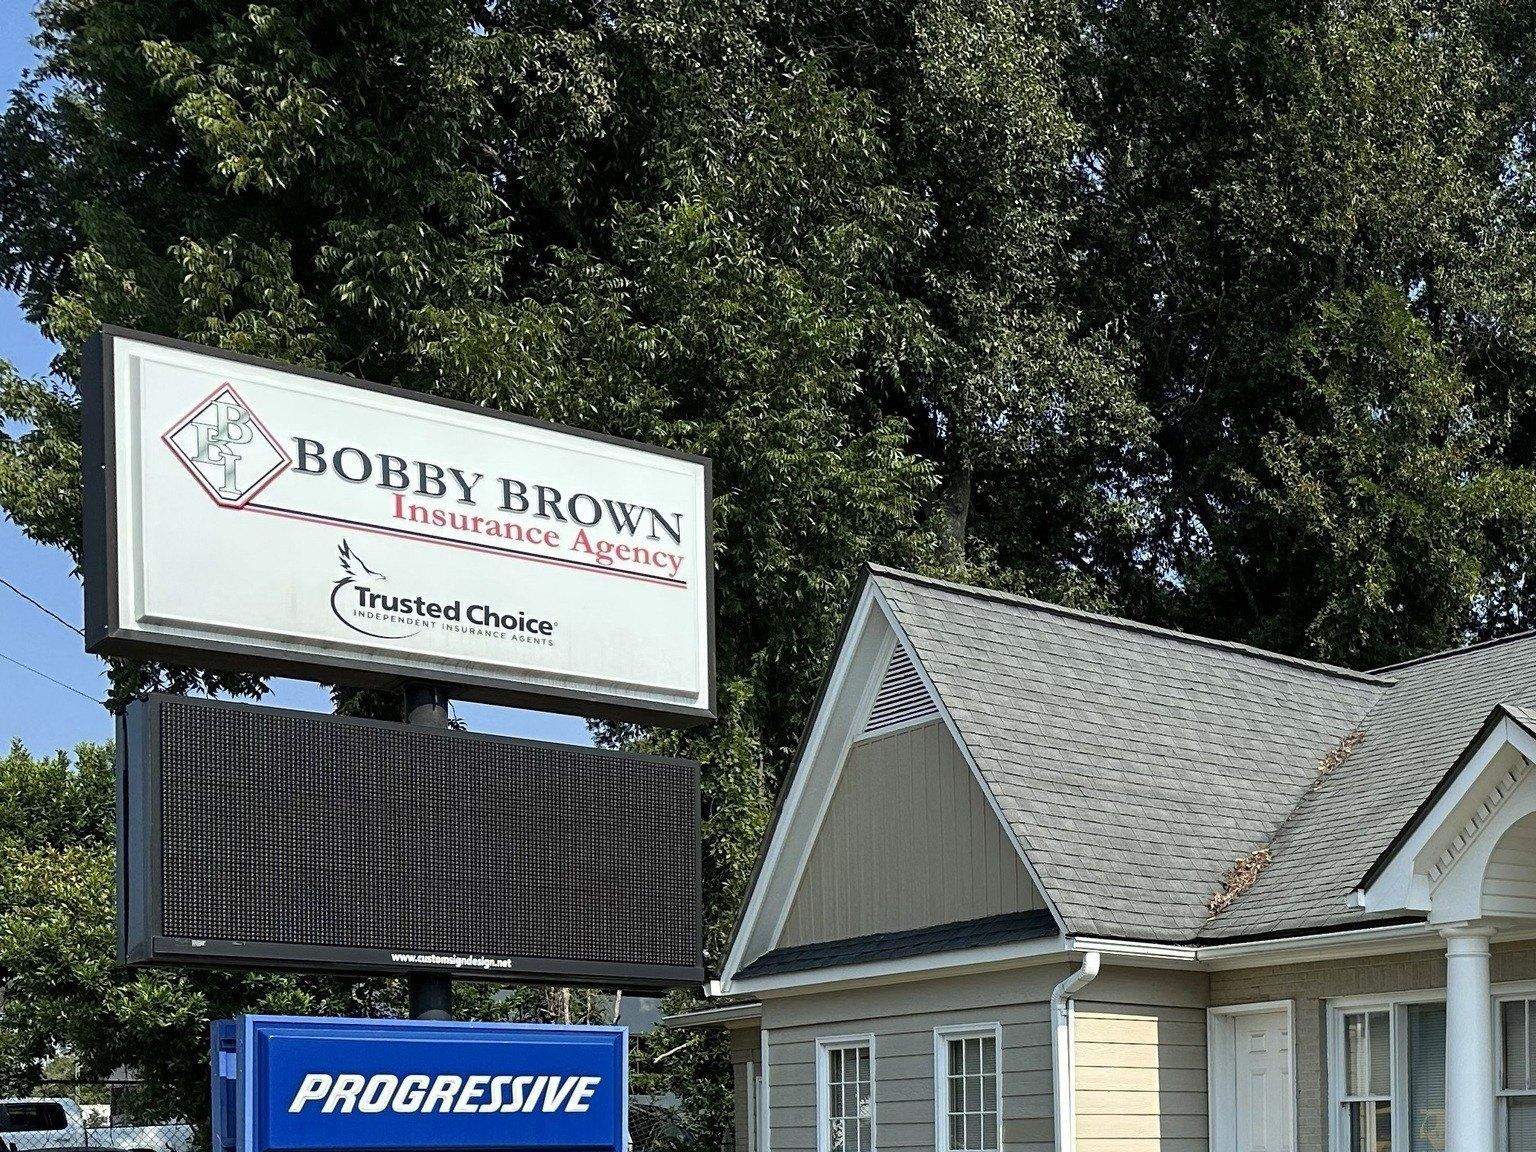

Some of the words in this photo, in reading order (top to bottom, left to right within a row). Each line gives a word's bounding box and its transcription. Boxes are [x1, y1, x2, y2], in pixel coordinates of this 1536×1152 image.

[290, 436, 484, 506] BOBBY
[497, 477, 684, 546] BROWN
[392, 493, 560, 548] Insurance
[570, 528, 684, 577] Agency
[353, 609, 436, 629] INDEPENDENT
[442, 623, 506, 640] INSURANCE
[511, 634, 554, 647] AGENTS
[354, 585, 461, 621] Trusted
[466, 604, 554, 636] Choice
[391, 953, 512, 969] www.customsigndesign.net
[288, 1073, 601, 1113] PROGRESSIVE
